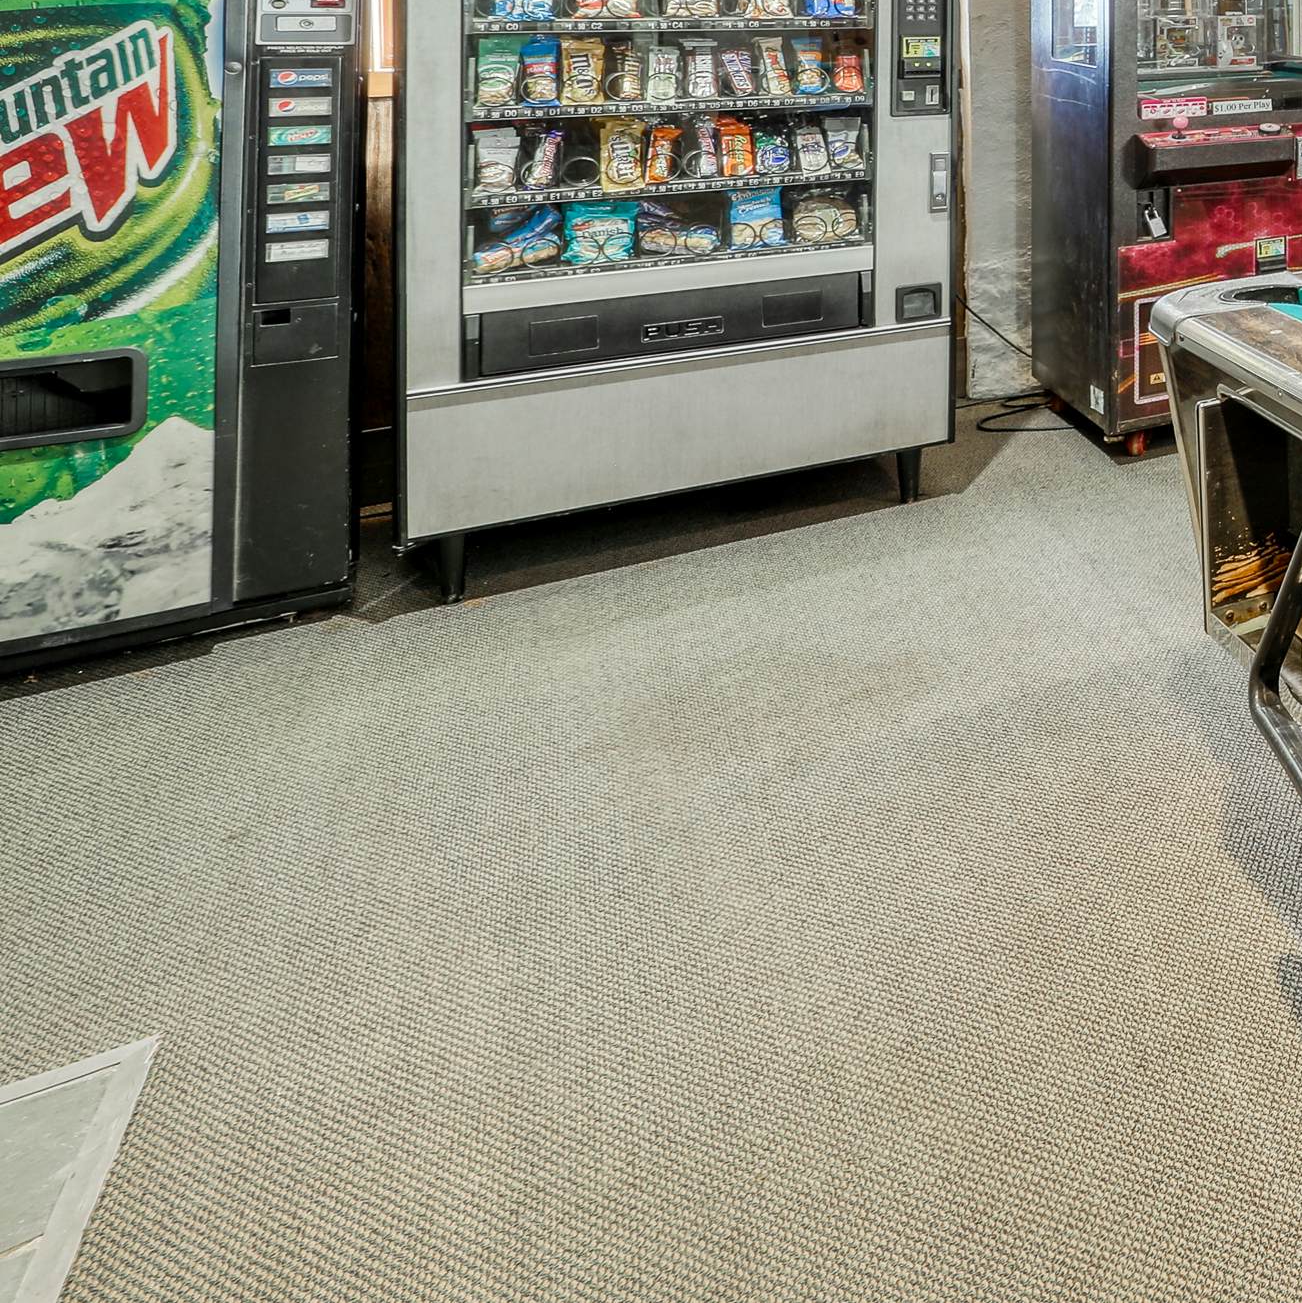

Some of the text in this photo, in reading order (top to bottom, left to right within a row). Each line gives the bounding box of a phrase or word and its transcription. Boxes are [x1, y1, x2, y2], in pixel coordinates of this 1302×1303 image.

[549, 108, 560, 116] D1
[1214, 101, 1270, 113] $1.00 Per Play
[592, 189, 603, 197] E2
[645, 321, 722, 341] PUSH
